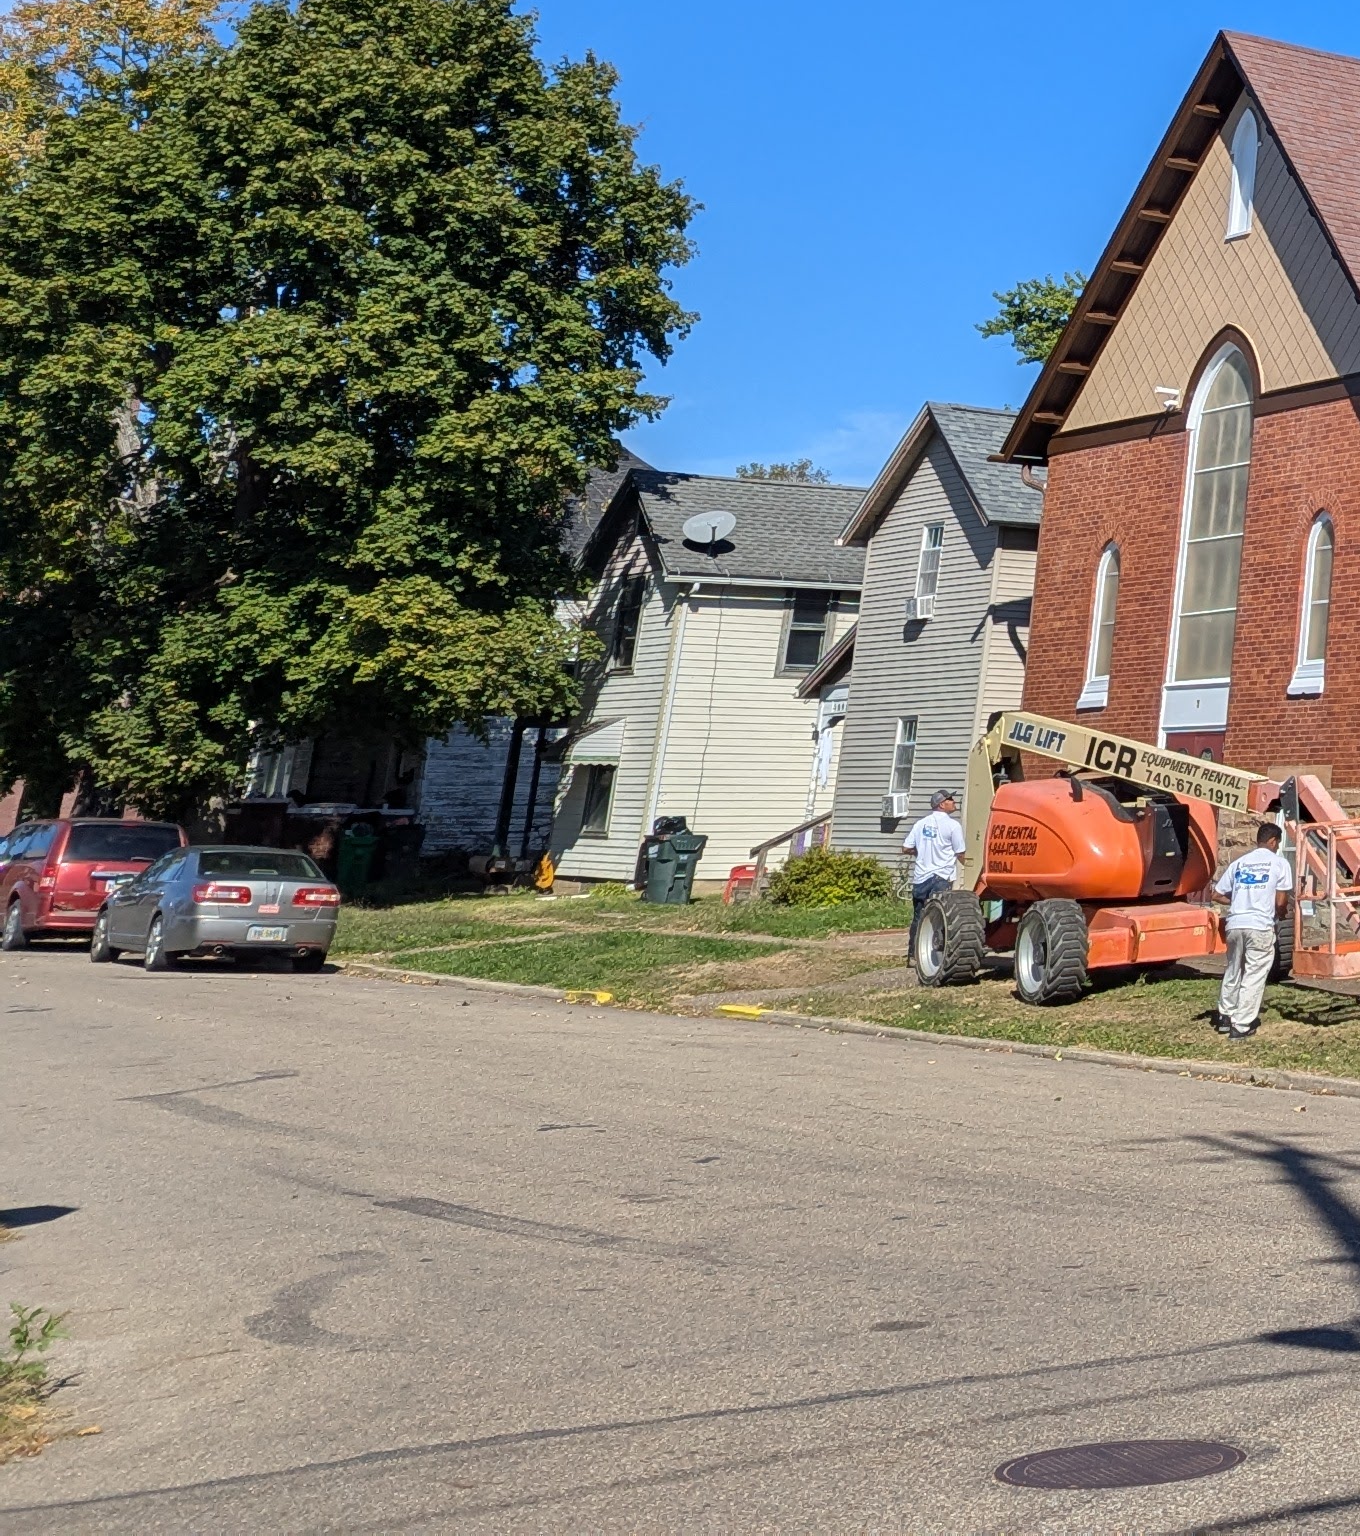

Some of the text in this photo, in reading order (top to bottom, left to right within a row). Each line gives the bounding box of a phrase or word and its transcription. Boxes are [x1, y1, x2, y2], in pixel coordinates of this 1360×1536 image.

[1009, 721, 1066, 752] JLG LIFT
[1084, 736, 1137, 778] ICR
[1140, 751, 1242, 790] EQUIPMENT RENTAL
[1145, 769, 1239, 808] 740-676-1917
[1005, 825, 1038, 840] RENTAL
